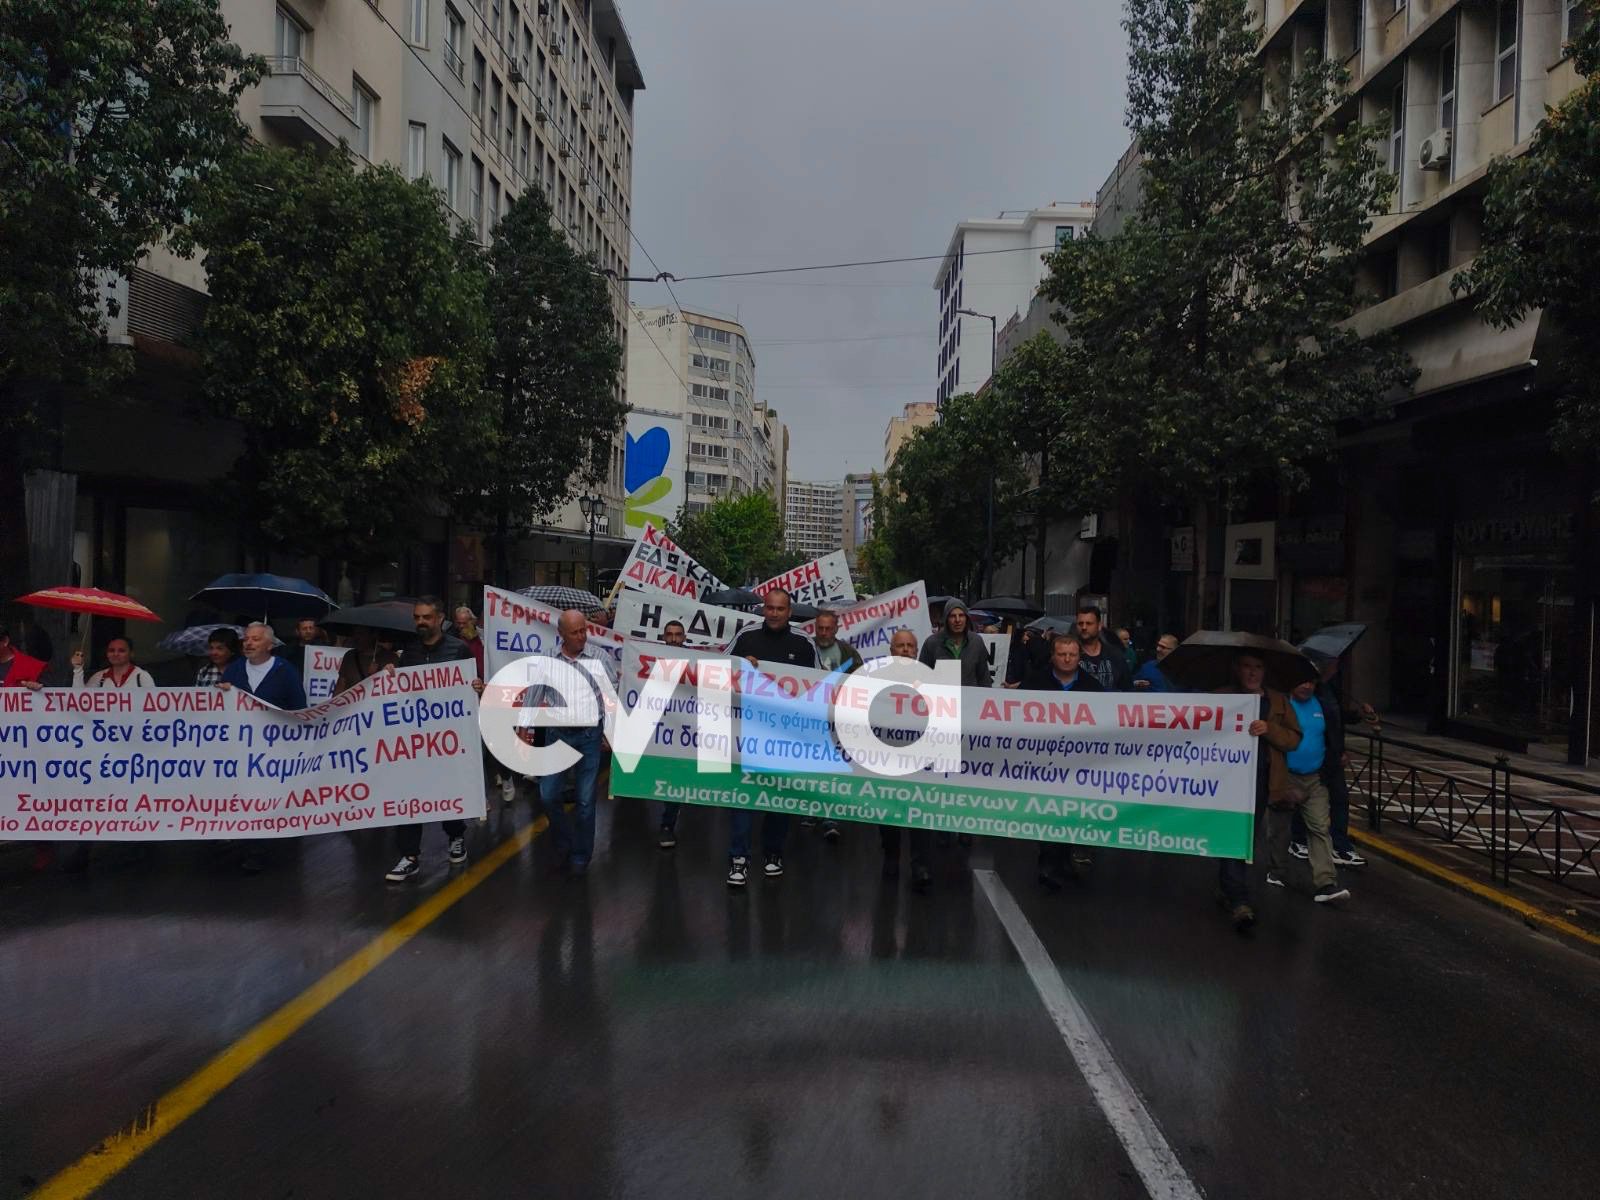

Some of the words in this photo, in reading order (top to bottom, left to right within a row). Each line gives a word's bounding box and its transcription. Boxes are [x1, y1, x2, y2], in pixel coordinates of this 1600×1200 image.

[686, 560, 720, 587] ΚΑ
[486, 591, 551, 625] Τέρμα
[640, 603, 663, 628] Η
[687, 609, 756, 639] ΔΙΚ
[835, 590, 920, 631] μπαιγμό
[313, 652, 344, 670] Συν
[496, 631, 541, 653] ΕΔΩ
[0, 692, 33, 712] ΜΕ
[44, 692, 132, 712] ΣΤΑΘΕΡΗ
[143, 691, 225, 712] ΔΟΥΛΕΙΑ
[236, 691, 270, 712] ΚΑ
[371, 665, 469, 697] ΕΙΣΟΔΗΜΑ.
[309, 678, 337, 697] ΕΞΑ
[637, 654, 869, 710] ΣΥΝΕΧΙΖΟΥΜΕ
[890, 692, 957, 718] ΤΟΝ
[979, 698, 1096, 726] ΑΓΩΝΑ
[1117, 703, 1224, 731] ΜΕΧΡΙ
[36, 725, 84, 748] σας
[92, 719, 133, 742] δεν
[142, 718, 230, 747] έσβησε
[238, 724, 253, 747] η
[262, 717, 330, 748] φωτιά
[332, 711, 374, 736] στην
[382, 697, 472, 728] Εύβοια.
[626, 689, 642, 709] Οι
[646, 695, 721, 722] καμινάδες
[723, 703, 754, 721] από
[757, 710, 777, 728] τις
[864, 725, 882, 739] να
[886, 726, 964, 748] καπνίζουν
[968, 734, 991, 750] για
[996, 736, 1012, 750] τα
[1016, 736, 1109, 758] συμφέροντα
[1114, 742, 1143, 756] των
[1146, 741, 1251, 766] εργαζομένων
[45, 759, 92, 785] σας
[100, 752, 206, 784] έσβησαν
[213, 759, 238, 778] τα
[247, 752, 325, 784] Καμίνια
[328, 747, 369, 774] της
[375, 729, 466, 764] ΛΑΡΚΟ.
[652, 721, 674, 745] Τα
[680, 724, 729, 757] δάση
[735, 735, 758, 753] να
[764, 738, 891, 766] αποτελέσουν
[897, 753, 994, 778] πνεύμονα
[999, 758, 1070, 783] λαϊκών
[1075, 767, 1219, 797] συμφερόντων
[17, 793, 129, 817] Σωματεία
[134, 793, 282, 817] Απολυμένων
[285, 782, 370, 809] ΛΑΡΚΟ
[741, 768, 852, 796] Σωματεία
[1024, 797, 1118, 822] ΛΑΡΚΟ
[24, 815, 160, 836] Δασεργατών
[180, 805, 376, 836] Ρητινοπαραγωγών
[383, 798, 464, 818] Εύβοιας
[654, 780, 750, 804] Σωματείο
[754, 790, 888, 820] Δασεργατών
[907, 807, 1111, 843] Ρητινοπαραγωγών
[1118, 827, 1208, 856] Εύβοιας
